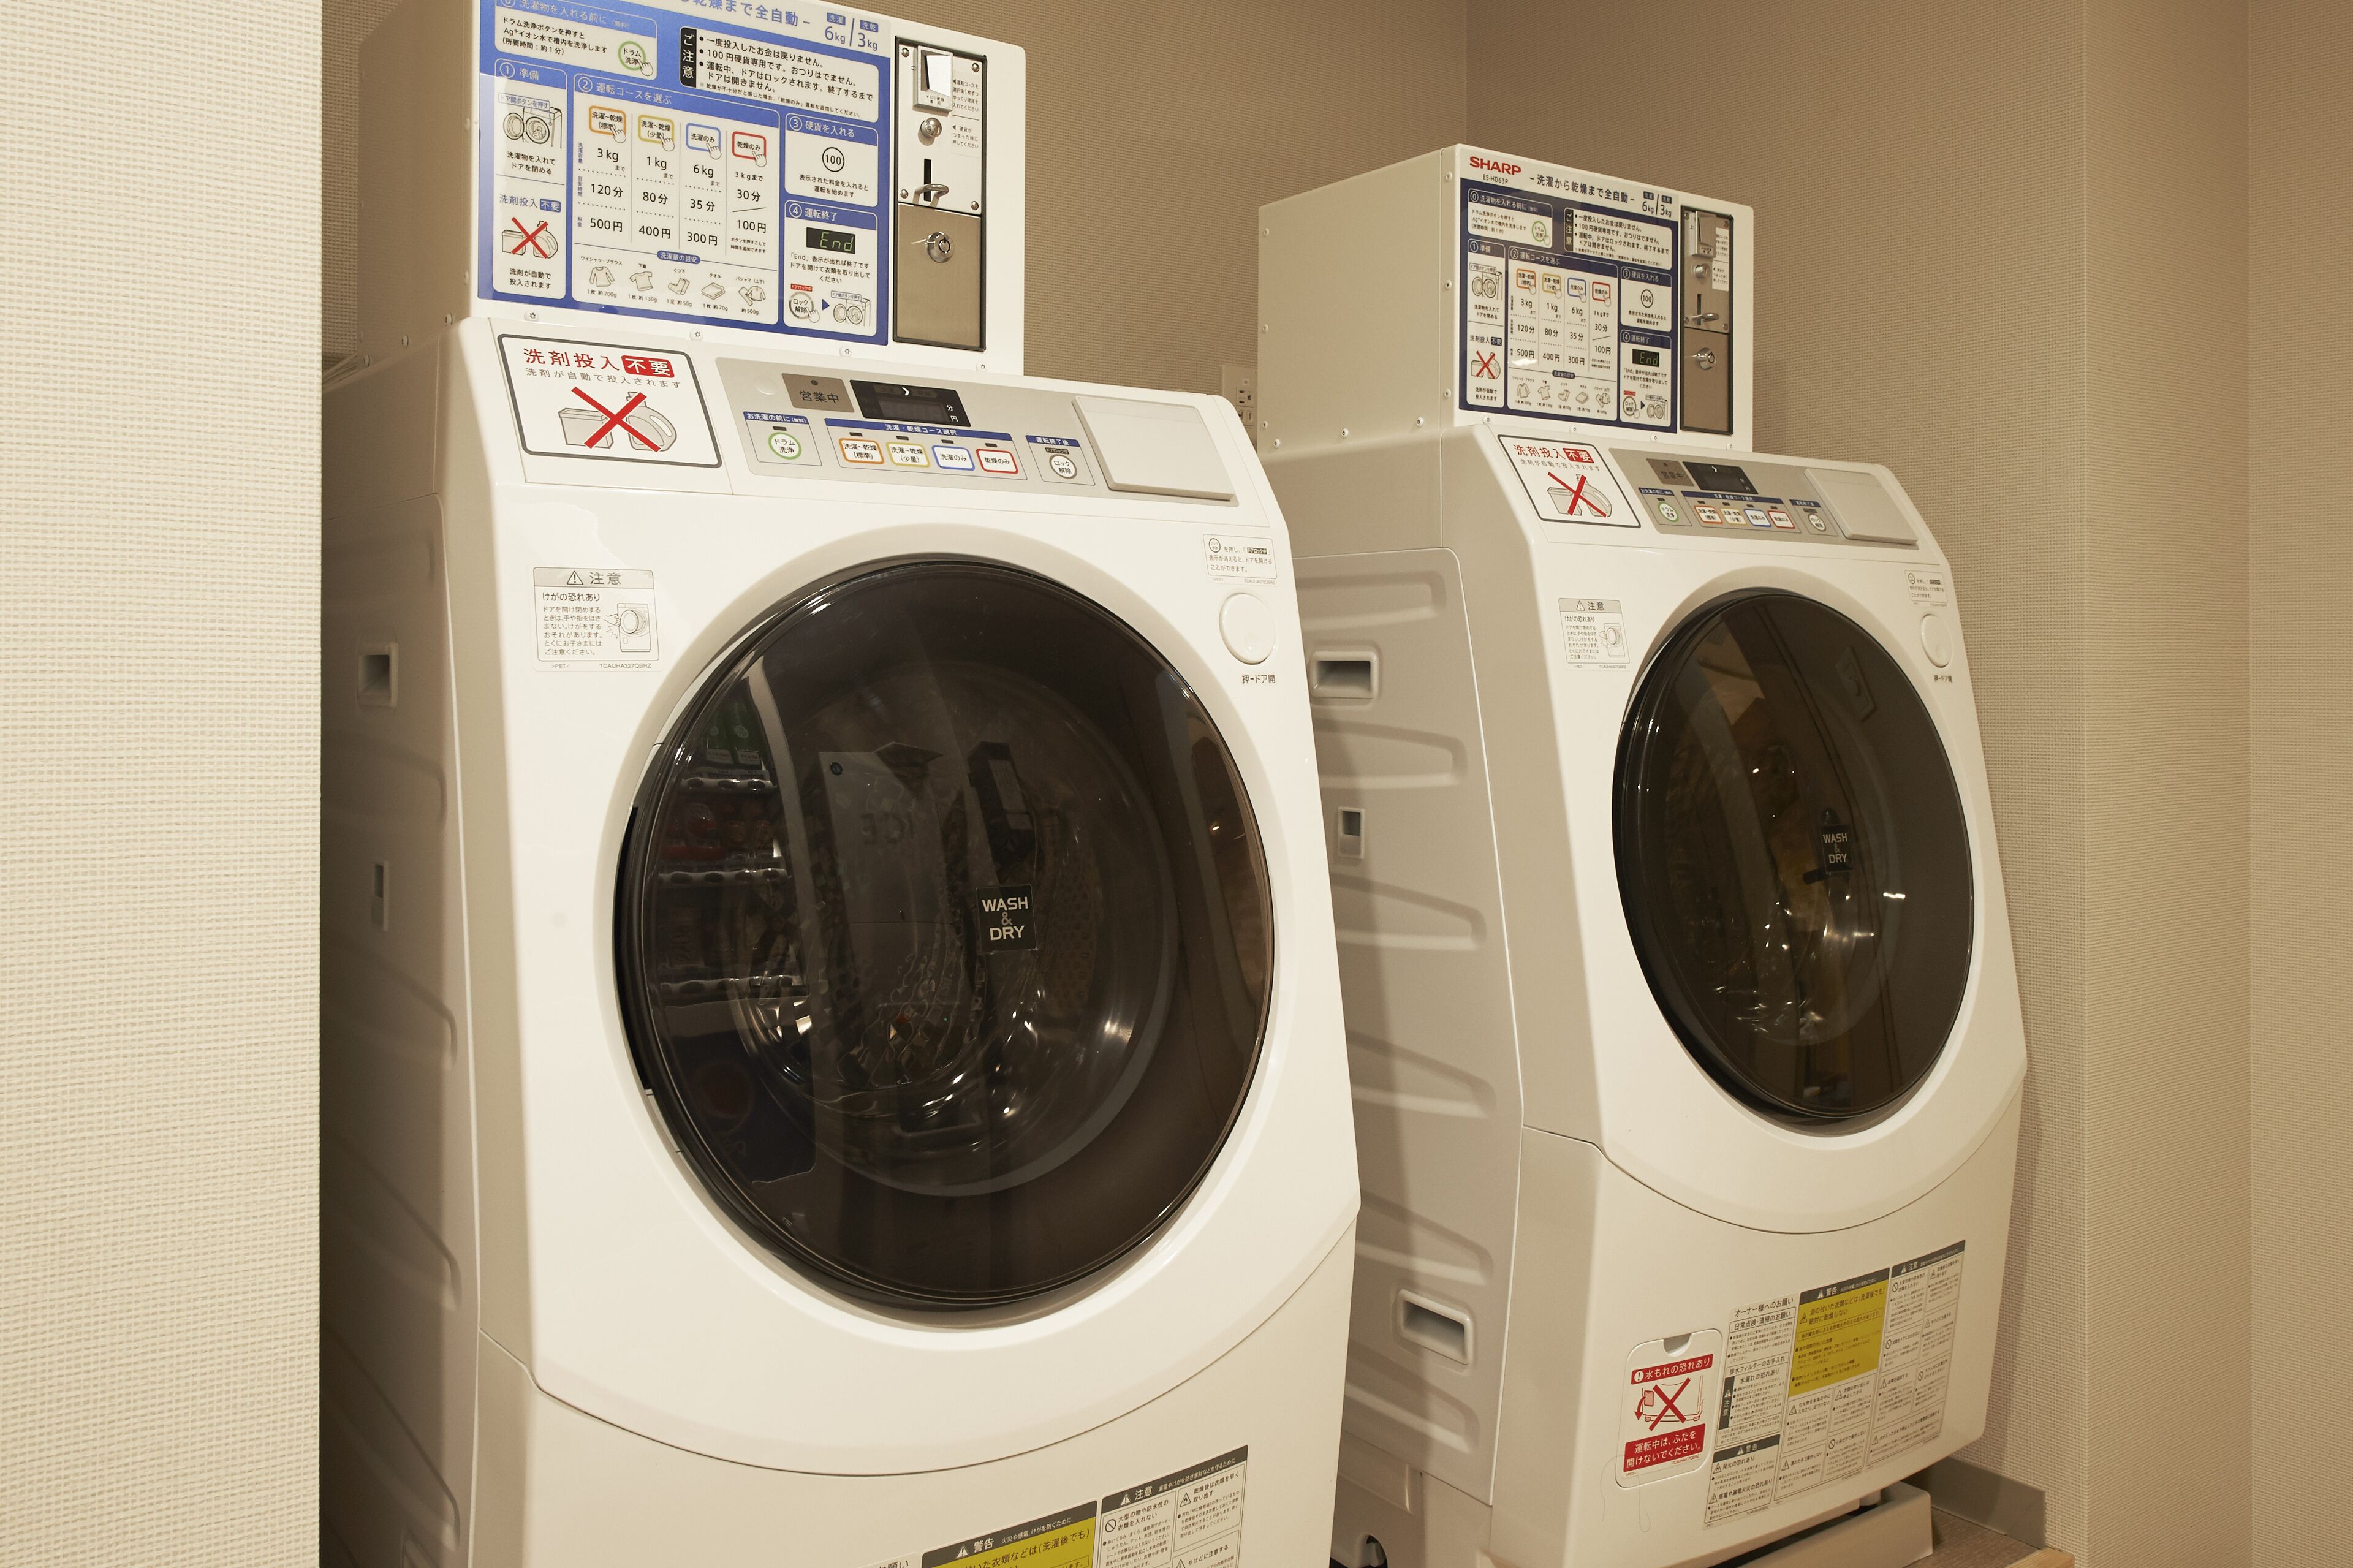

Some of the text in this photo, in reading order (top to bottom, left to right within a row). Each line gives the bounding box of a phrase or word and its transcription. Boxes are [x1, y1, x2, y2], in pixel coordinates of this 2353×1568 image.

[503, 17, 585, 39] ドラム洗浄ボタンを押すと
[624, 48, 641, 58] ドラム
[682, 34, 694, 78] ご注意
[707, 37, 824, 67] 一度投入したお金は戻りません。
[520, 68, 539, 80] 準備
[707, 73, 775, 93] ドアは開きません。
[596, 82, 672, 105] 運転コースを選ぶ
[805, 120, 855, 138] 硬貨を入れる
[691, 132, 715, 143] 洗濯のみ
[737, 141, 760, 151] 乾燥のみ
[507, 151, 555, 165] 洗濯物を入れて
[825, 154, 842, 165] 100
[1469, 156, 1521, 175] SHARP
[511, 163, 552, 175] ドアを閉める
[800, 174, 869, 191] 表示された料金を入れると
[1482, 174, 1509, 184] ES-HD63P
[814, 186, 854, 197] 運転を始めます
[805, 207, 838, 221] 運転終了
[820, 232, 854, 252] End
[510, 268, 551, 279] 洗剤が自動で
[791, 262, 871, 279] ドアを開けて衣類を取り出して
[510, 278, 551, 289] 投入されます
[819, 275, 842, 284] ください
[523, 347, 670, 376] 洗剤投入 不要
[525, 367, 681, 389] 洗剤が自動で投入されます
[800, 390, 839, 404] 営業中
[746, 413, 790, 422] お洗濯の前に
[1512, 444, 1592, 463] 洗剤投入 不要
[589, 572, 622, 585] 注意
[542, 592, 601, 602] けがの恐れあり
[1587, 601, 1605, 611] 注意
[1822, 833, 1848, 843] WASH
[1834, 843, 1841, 853] &
[1828, 853, 1847, 863] DRY
[982, 896, 1029, 912] WASH
[1001, 911, 1013, 926] &
[990, 925, 1025, 941] DRY
[1735, 1297, 1794, 1318] オーナー様へのお願い
[1645, 1358, 1711, 1380] 水もれの恐れあり
[1634, 1430, 1697, 1454] 運転中は、ふたを
[1626, 1445, 1702, 1469] 開けないでください。
[1134, 1485, 1153, 1501] 注意
[1193, 1490, 1214, 1503] 取り出す
[1117, 1512, 1158, 1531] 衣類を入れない
[973, 1538, 995, 1553] 警告
